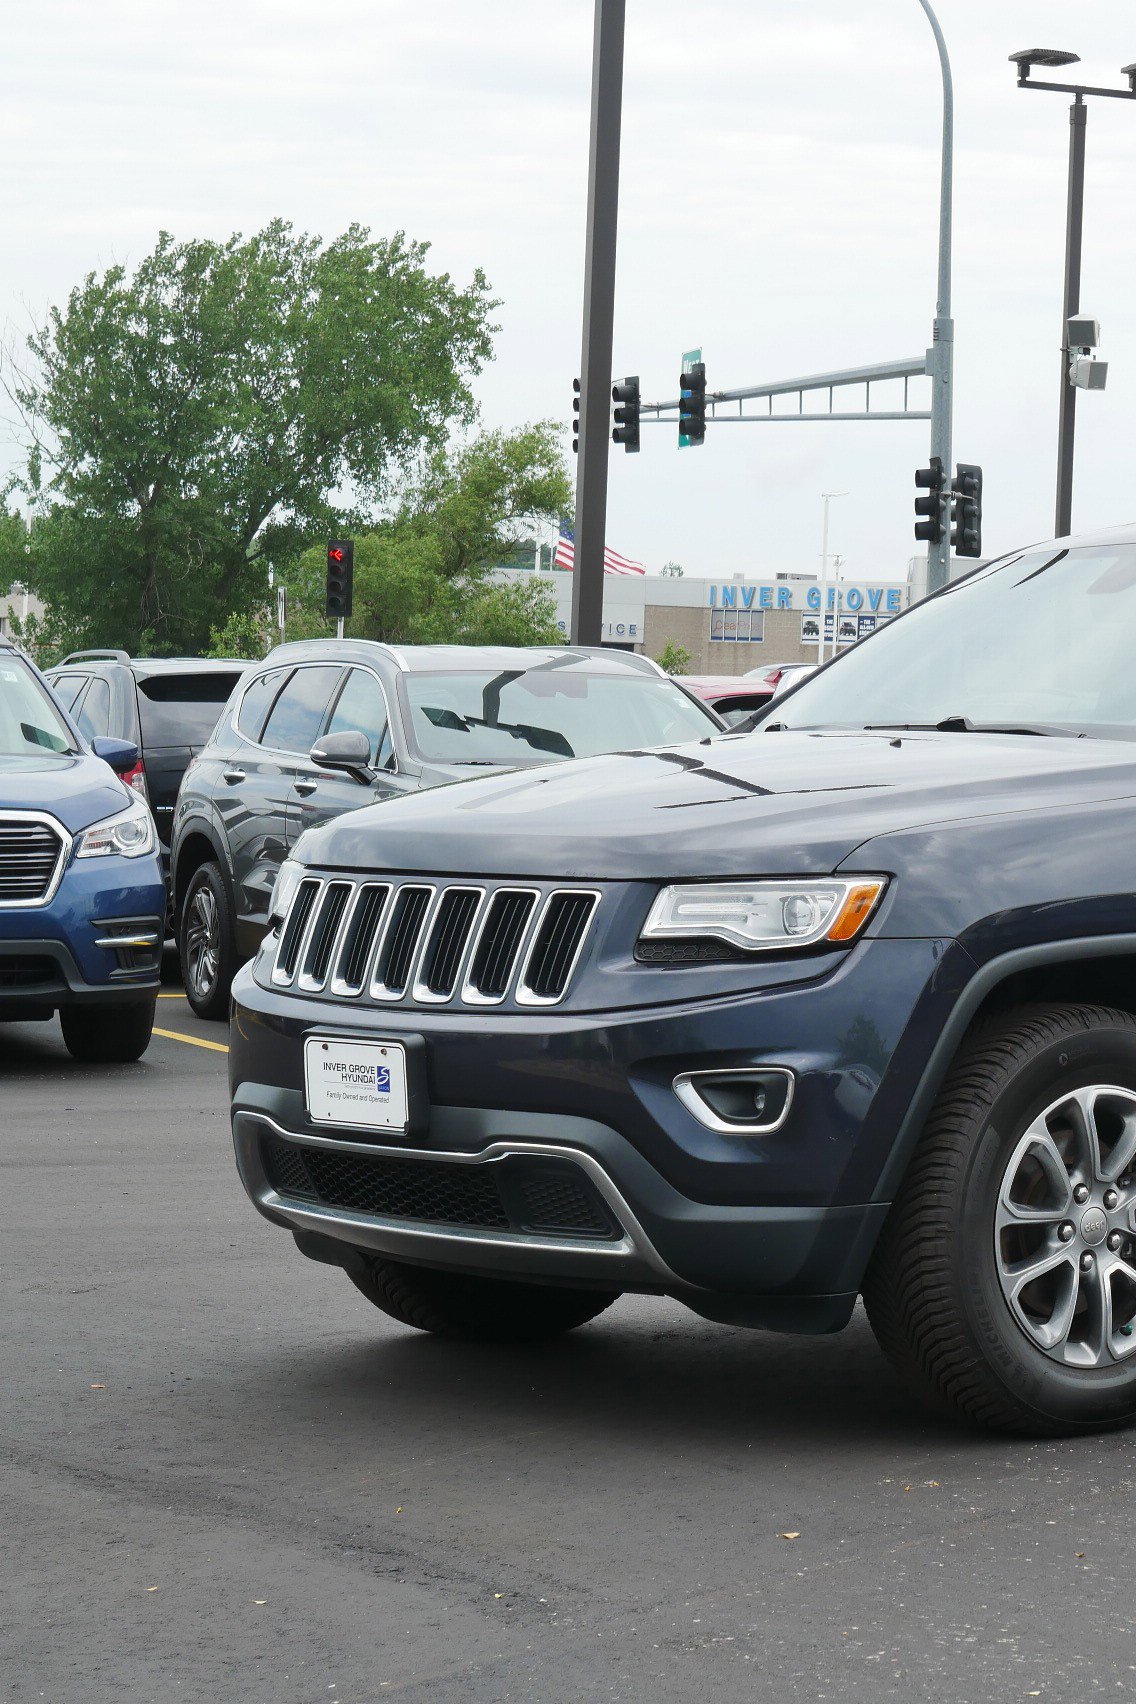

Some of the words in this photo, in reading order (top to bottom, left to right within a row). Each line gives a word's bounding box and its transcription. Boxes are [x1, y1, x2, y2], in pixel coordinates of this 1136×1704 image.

[709, 585, 793, 609] INVER
[806, 586, 902, 611] GROVE
[557, 620, 637, 635] SICE
[323, 1062, 347, 1072] INVER
[348, 1064, 375, 1075] GROVE
[341, 1073, 376, 1084] HYUNDAI
[326, 1091, 342, 1100] Family
[343, 1092, 359, 1101] Owned
[368, 1094, 390, 1104] Operated
